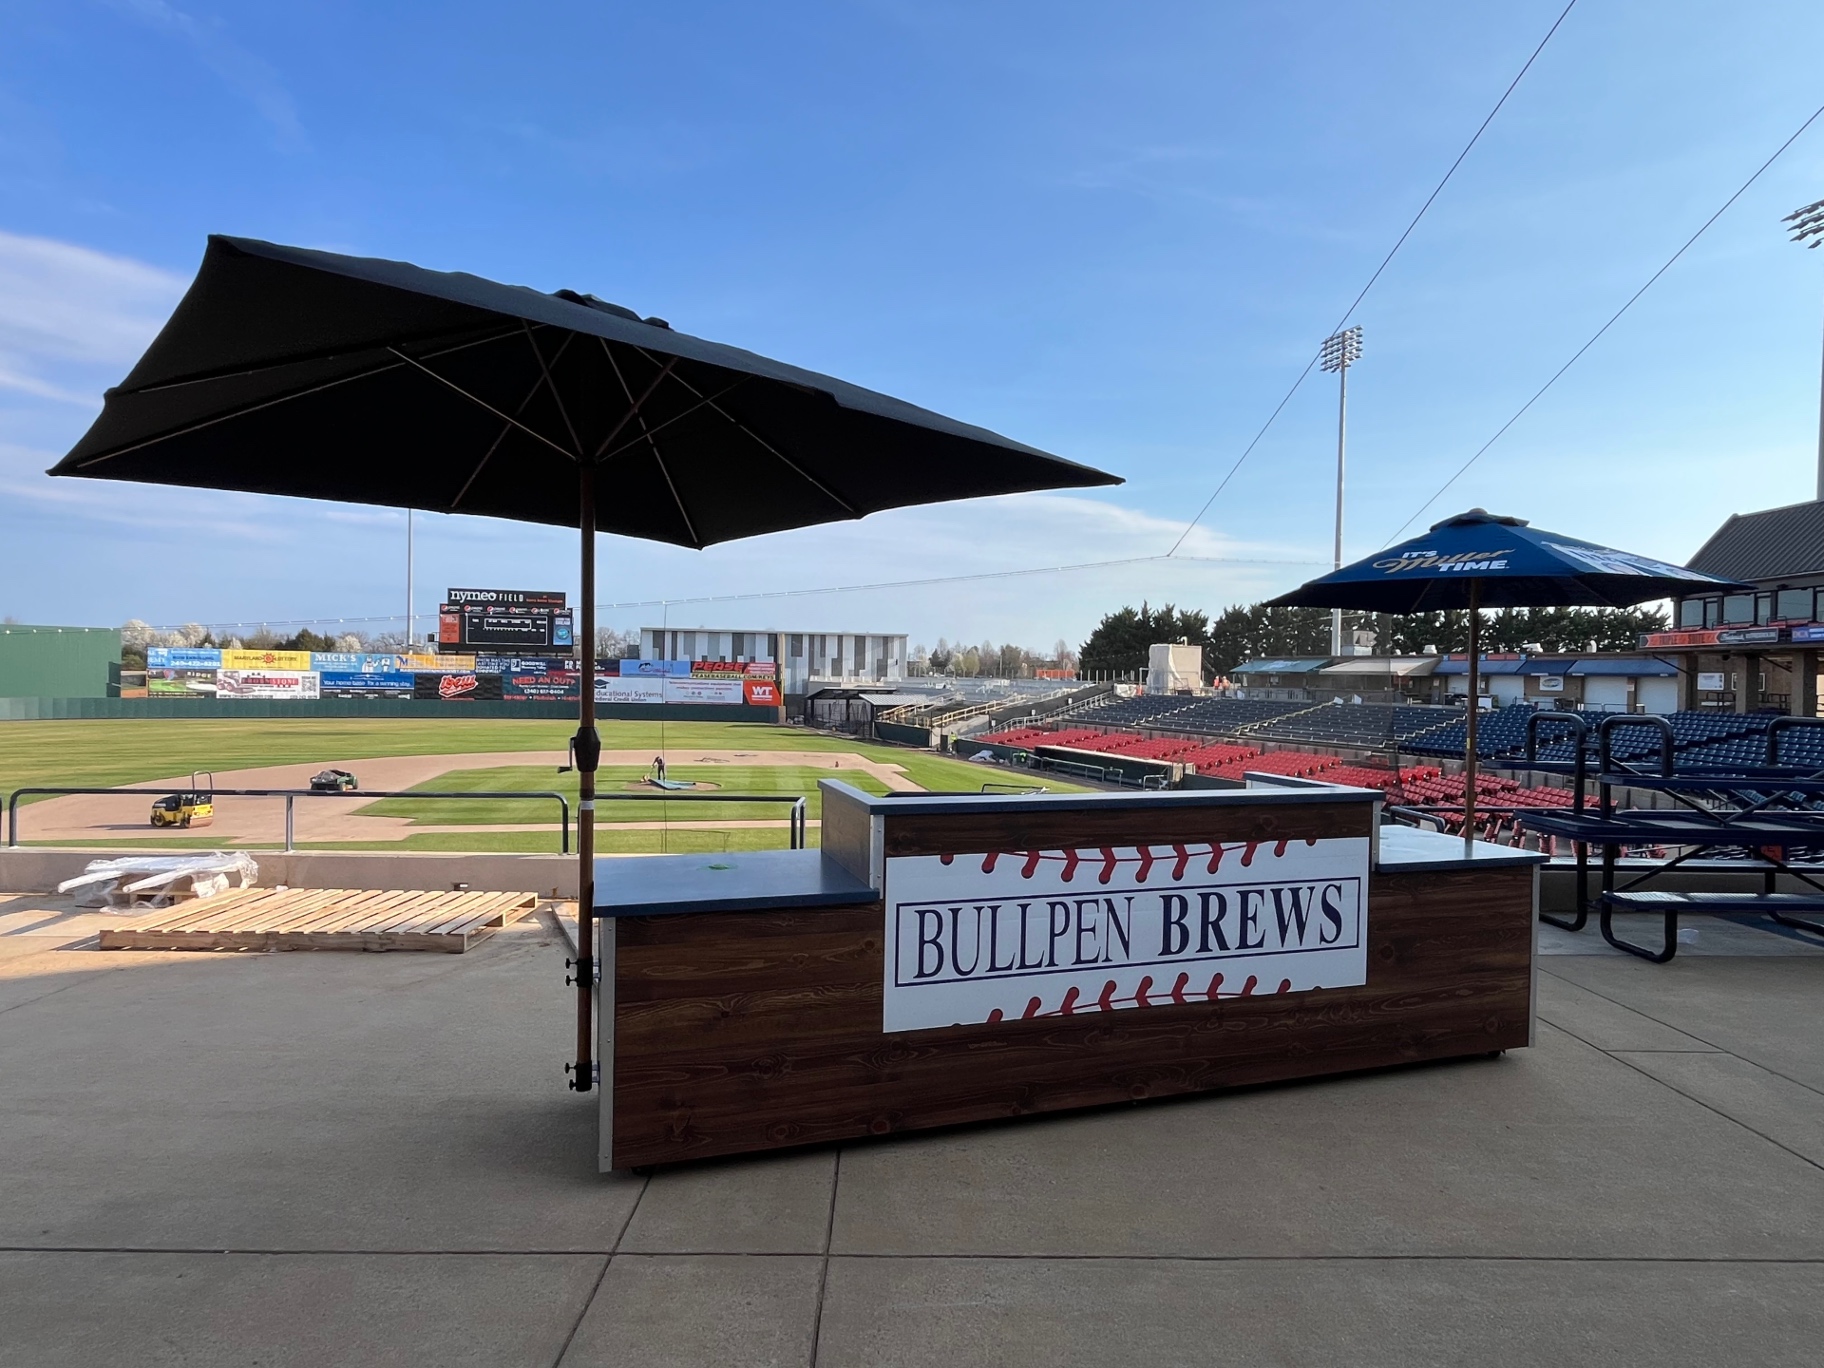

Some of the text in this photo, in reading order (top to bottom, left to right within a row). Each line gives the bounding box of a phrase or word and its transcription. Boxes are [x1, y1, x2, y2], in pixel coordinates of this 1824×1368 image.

[1402, 551, 1438, 559] IT'S
[1372, 548, 1517, 574] Miller
[450, 590, 497, 603] nymeo
[499, 593, 524, 602] FIELD
[315, 653, 357, 662] MICK'S
[693, 662, 744, 671] PEASE
[512, 677, 536, 685] NEED
[595, 690, 663, 699] ducational Systems
[752, 686, 773, 695] WT
[913, 883, 1343, 980] BULLPEN BREWS
